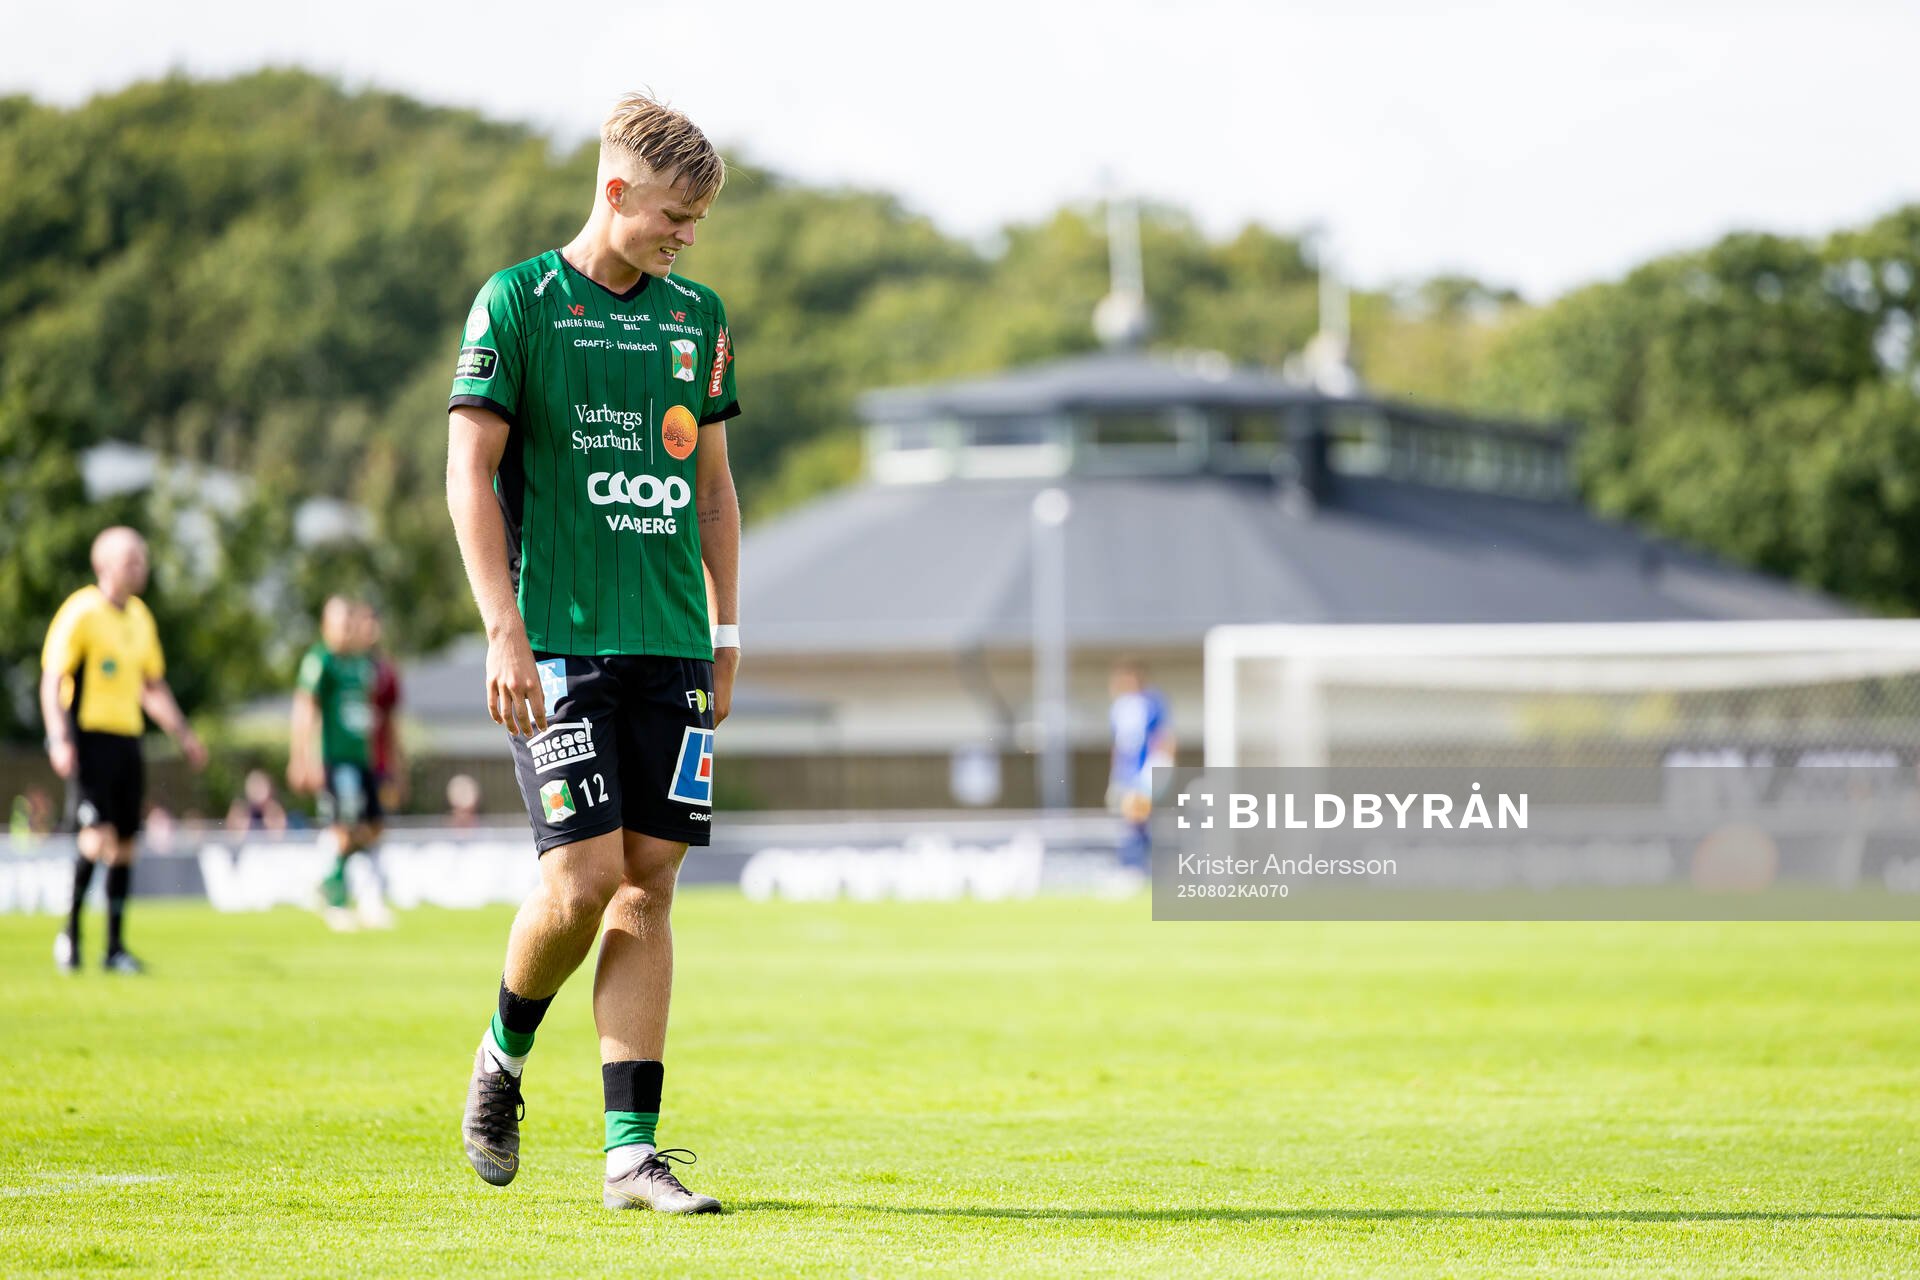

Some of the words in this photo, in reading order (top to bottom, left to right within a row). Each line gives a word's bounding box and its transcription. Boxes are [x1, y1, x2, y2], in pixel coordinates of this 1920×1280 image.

[609, 313, 651, 322] DELUXE
[554, 319, 582, 330] VARBERG
[623, 323, 641, 331] BIL
[573, 339, 606, 348] CRAFT
[616, 340, 658, 352] inviatech
[574, 403, 643, 432] Varbergs
[572, 429, 643, 455] Sparbank
[579, 773, 610, 808] 12
